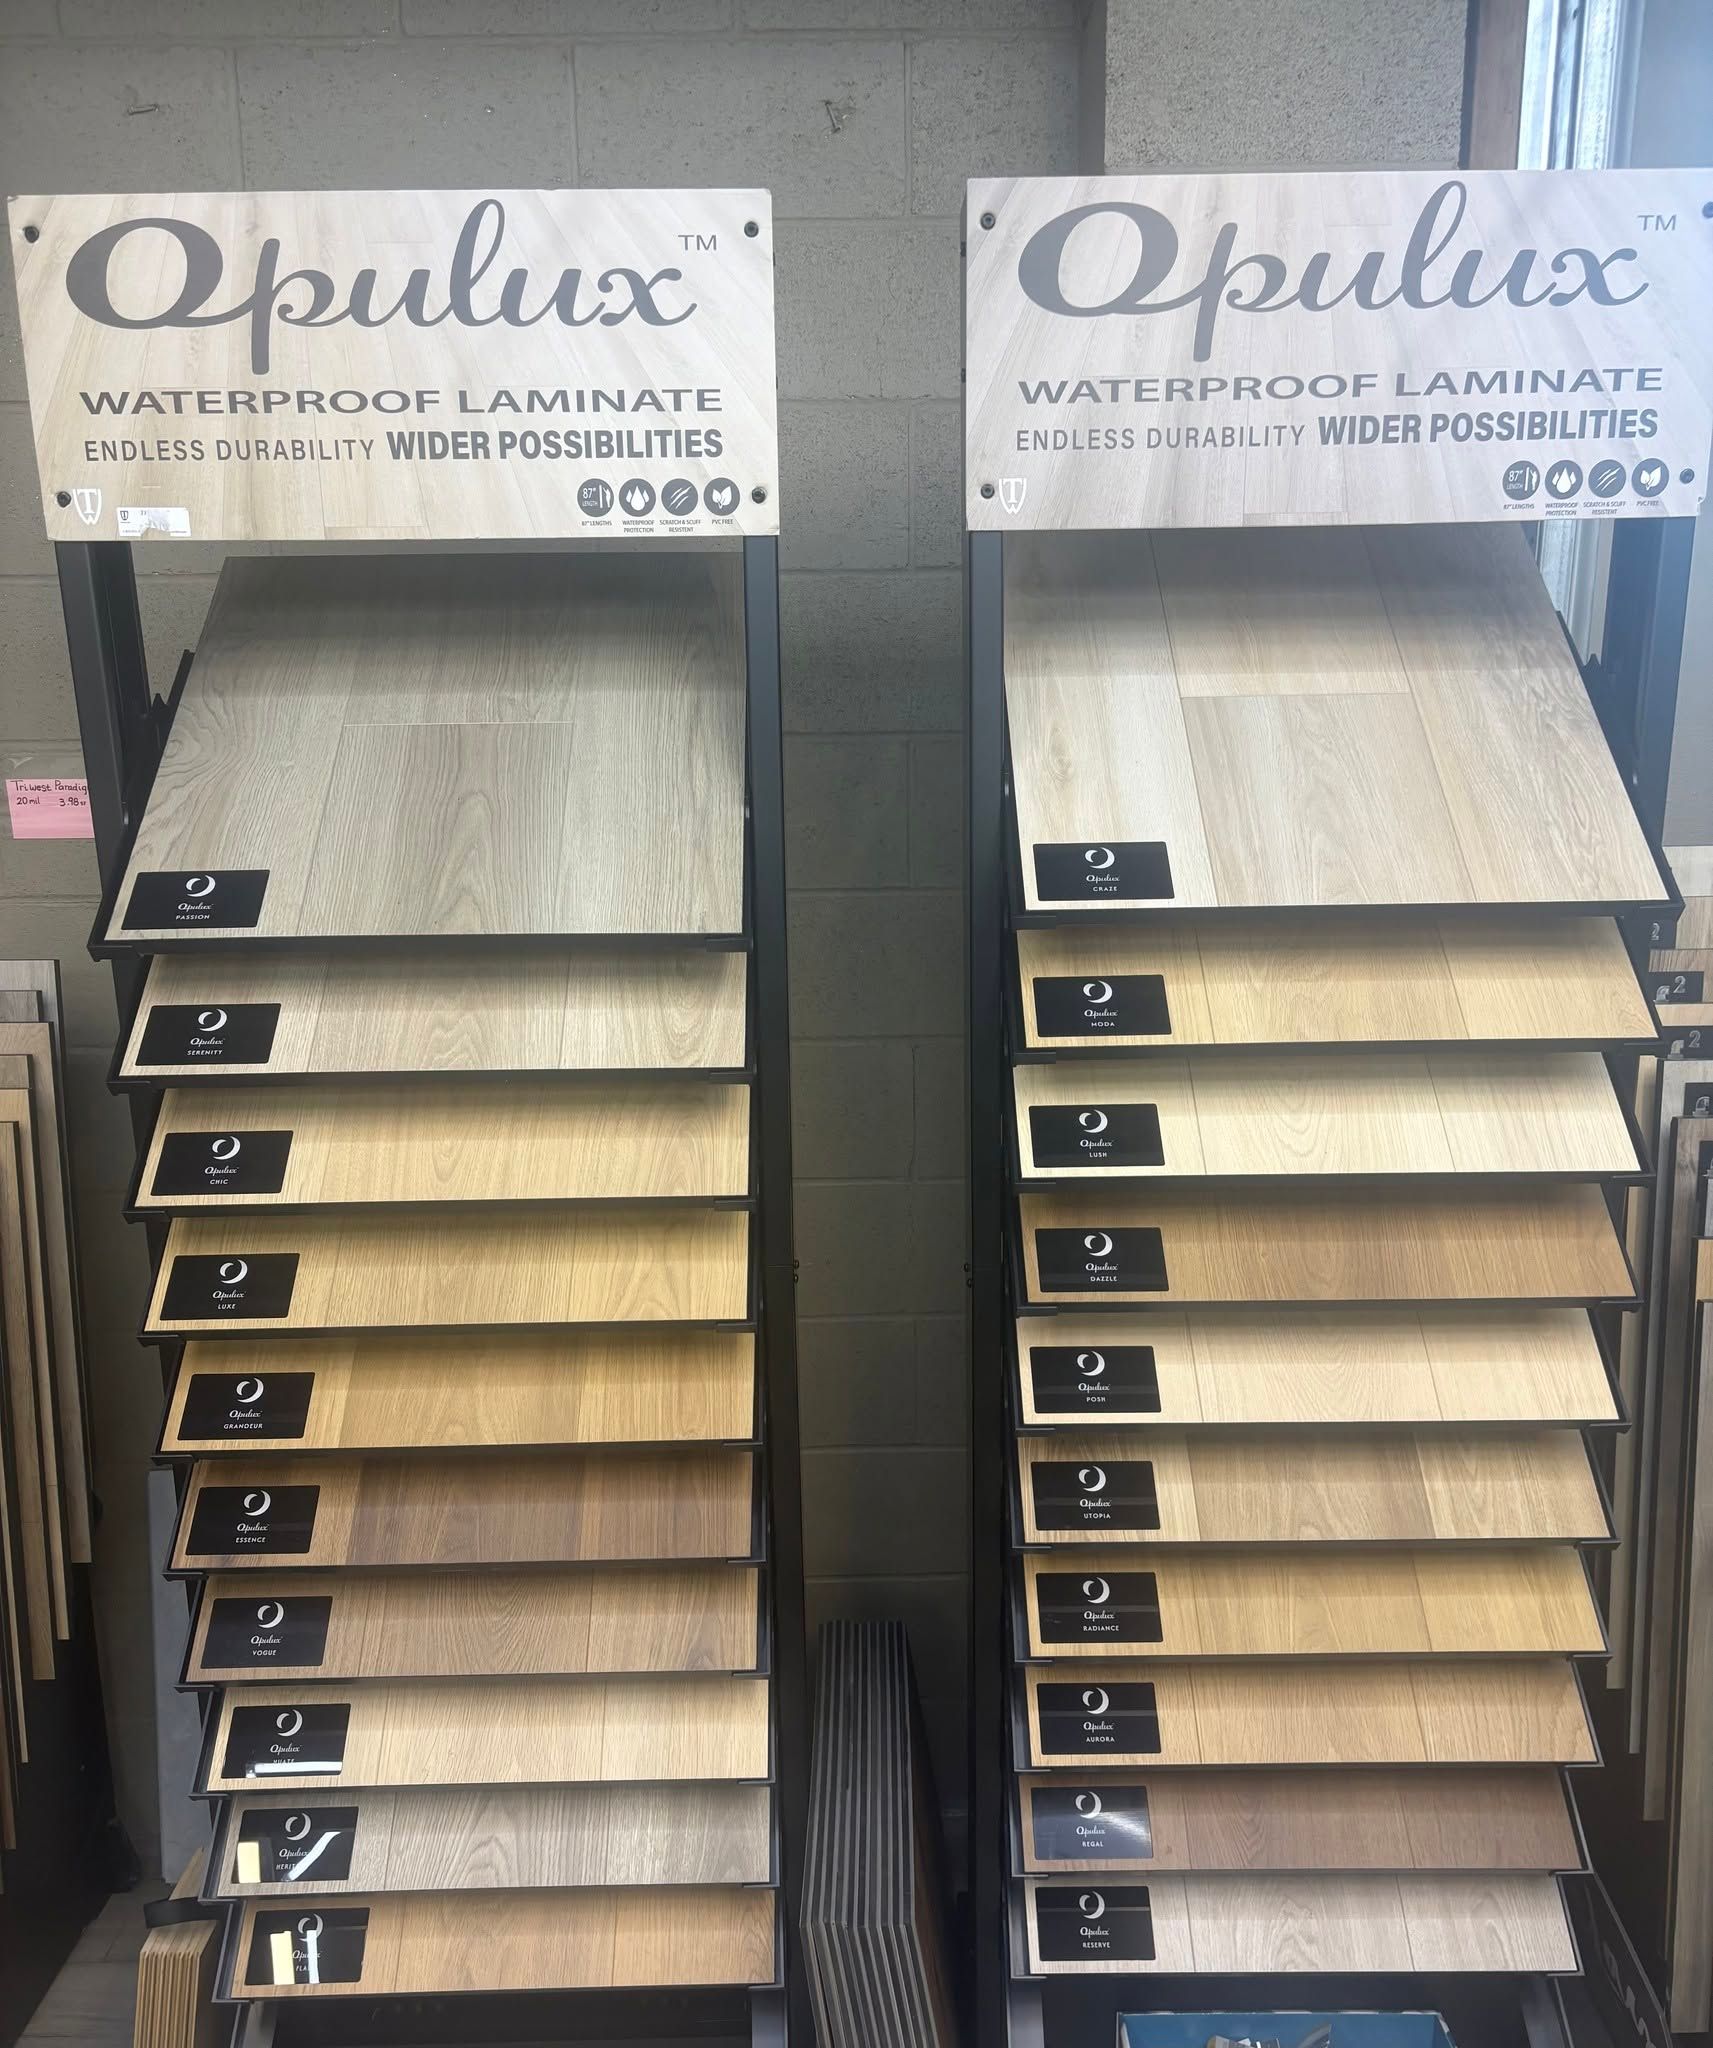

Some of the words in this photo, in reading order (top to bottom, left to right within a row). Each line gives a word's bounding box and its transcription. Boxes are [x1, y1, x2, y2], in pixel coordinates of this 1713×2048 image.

[1018, 180, 1650, 362] Opulux
[66, 199, 697, 375] Opulux
[1018, 374, 1378, 404] WATERPROOF
[1396, 368, 1662, 396] LAMINATE
[80, 390, 440, 415] WATERPROOF
[458, 389, 722, 413] LAMINATE
[1016, 428, 1135, 450] ENDLESS
[1147, 425, 1306, 449] DURABILITY
[1318, 414, 1421, 445] WIDER
[1430, 408, 1658, 443] POSSIBILITIES
[84, 440, 205, 461] ENDLESS
[216, 440, 374, 460] DURABILITY
[386, 430, 490, 460] WIDER
[498, 429, 723, 459] POSSIBILITIES
[1086, 874, 1120, 882] Opulux
[178, 902, 212, 911] Opulux
[1672, 976, 1686, 994] 2
[1084, 1008, 1118, 1018] Opulux
[190, 1036, 224, 1046] Opulux
[1688, 1030, 1701, 1048] 2
[1080, 1139, 1112, 1149] Opulux
[204, 1166, 238, 1176] Opulux
[1085, 1262, 1118, 1273] Opulux
[212, 1290, 245, 1300] Opulux
[1078, 1382, 1110, 1393] Opulux
[229, 1409, 262, 1420] Opulux
[1080, 1498, 1111, 1509] Opulux
[236, 1522, 269, 1533] Opulux
[1084, 1610, 1115, 1622] Opulux
[250, 1634, 282, 1646] Opulux
[1083, 1720, 1114, 1733] Opulux
[270, 1743, 300, 1754] Opulux
[1076, 1825, 1106, 1837] Opulux
[1080, 1926, 1110, 1938] Opulux
